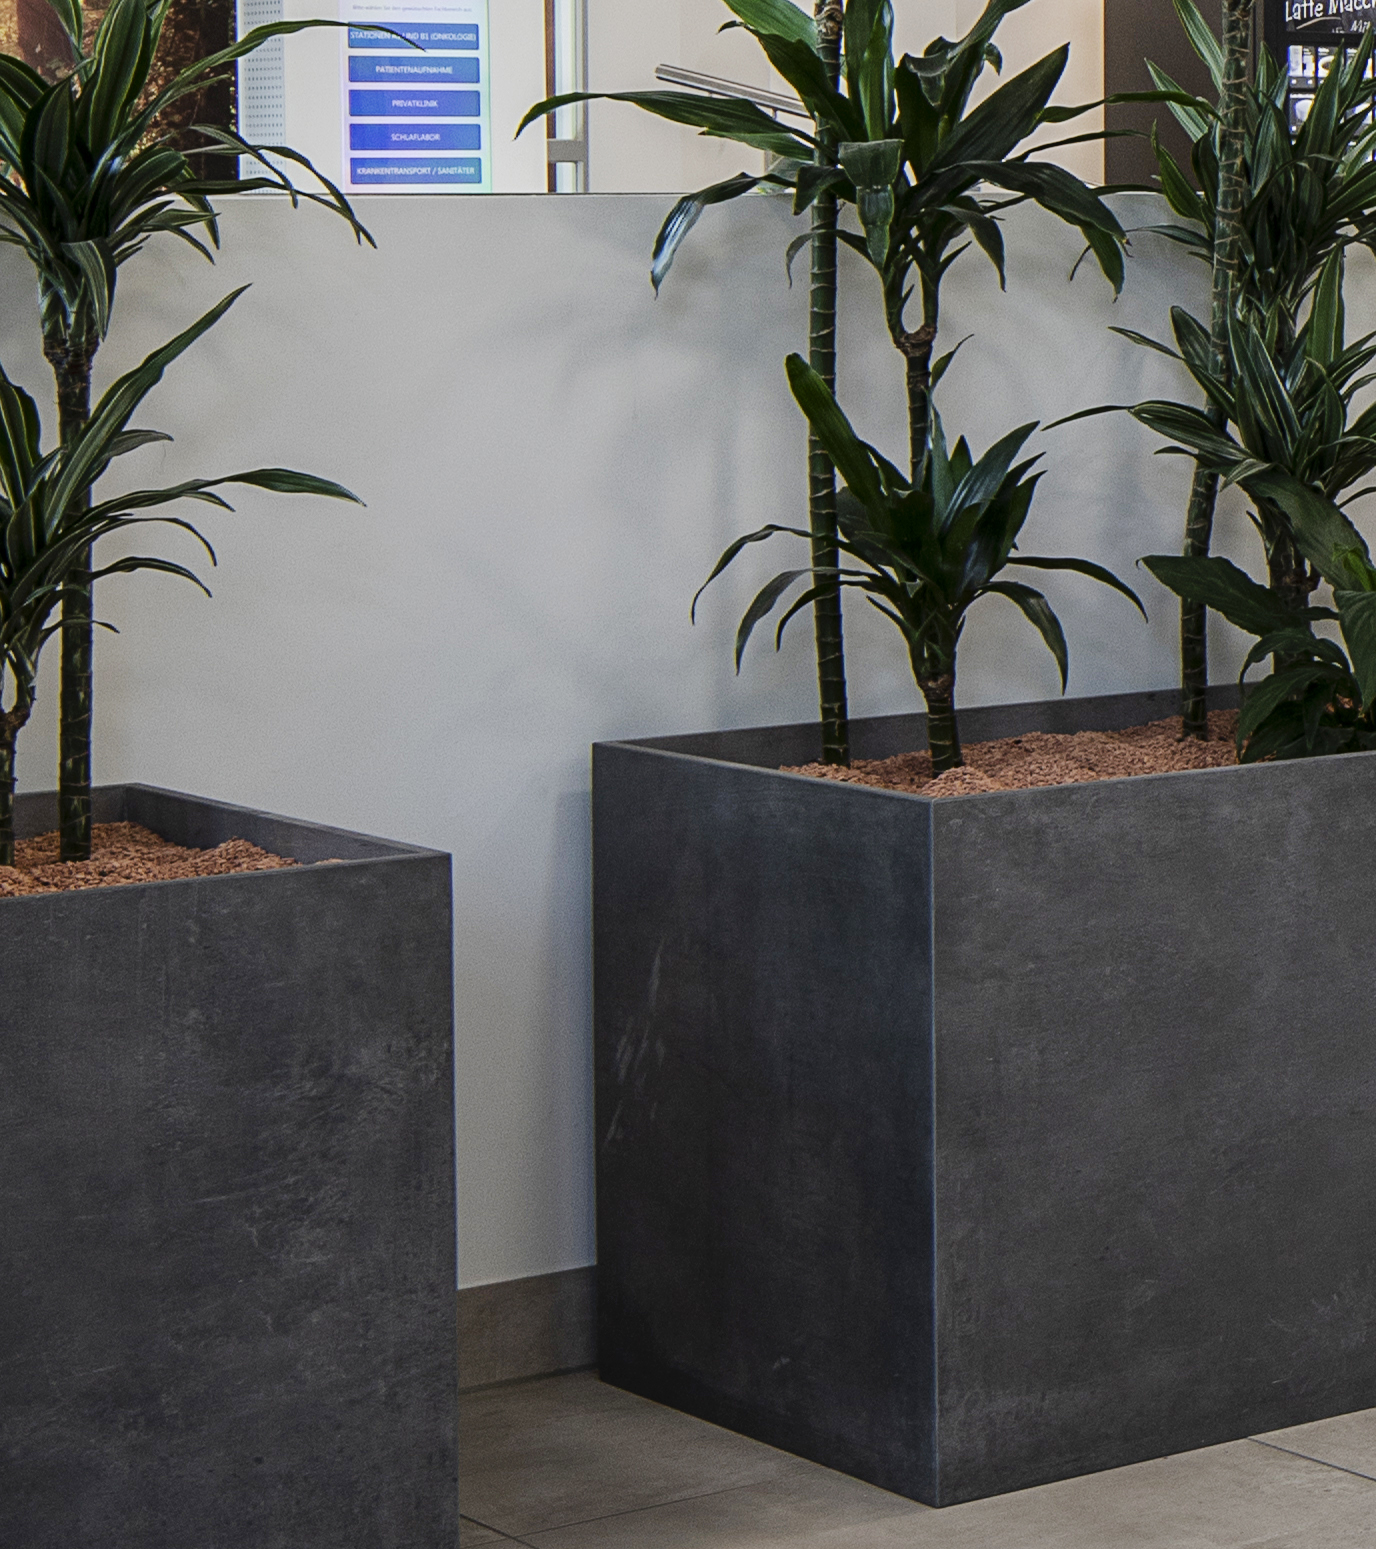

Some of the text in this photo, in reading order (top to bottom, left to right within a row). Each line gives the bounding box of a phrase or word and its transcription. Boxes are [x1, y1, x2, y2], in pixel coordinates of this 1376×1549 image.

[350, 31, 390, 40] STATIONEN
[430, 33, 476, 42] (ONKOLOGIE)
[375, 66, 453, 74] PATIENTENAUFNAHME
[392, 100, 438, 108] PRIVATKLINIK
[356, 167, 430, 176] KRANKENTRANSPORT
[438, 166, 475, 175] SANITÄTER
